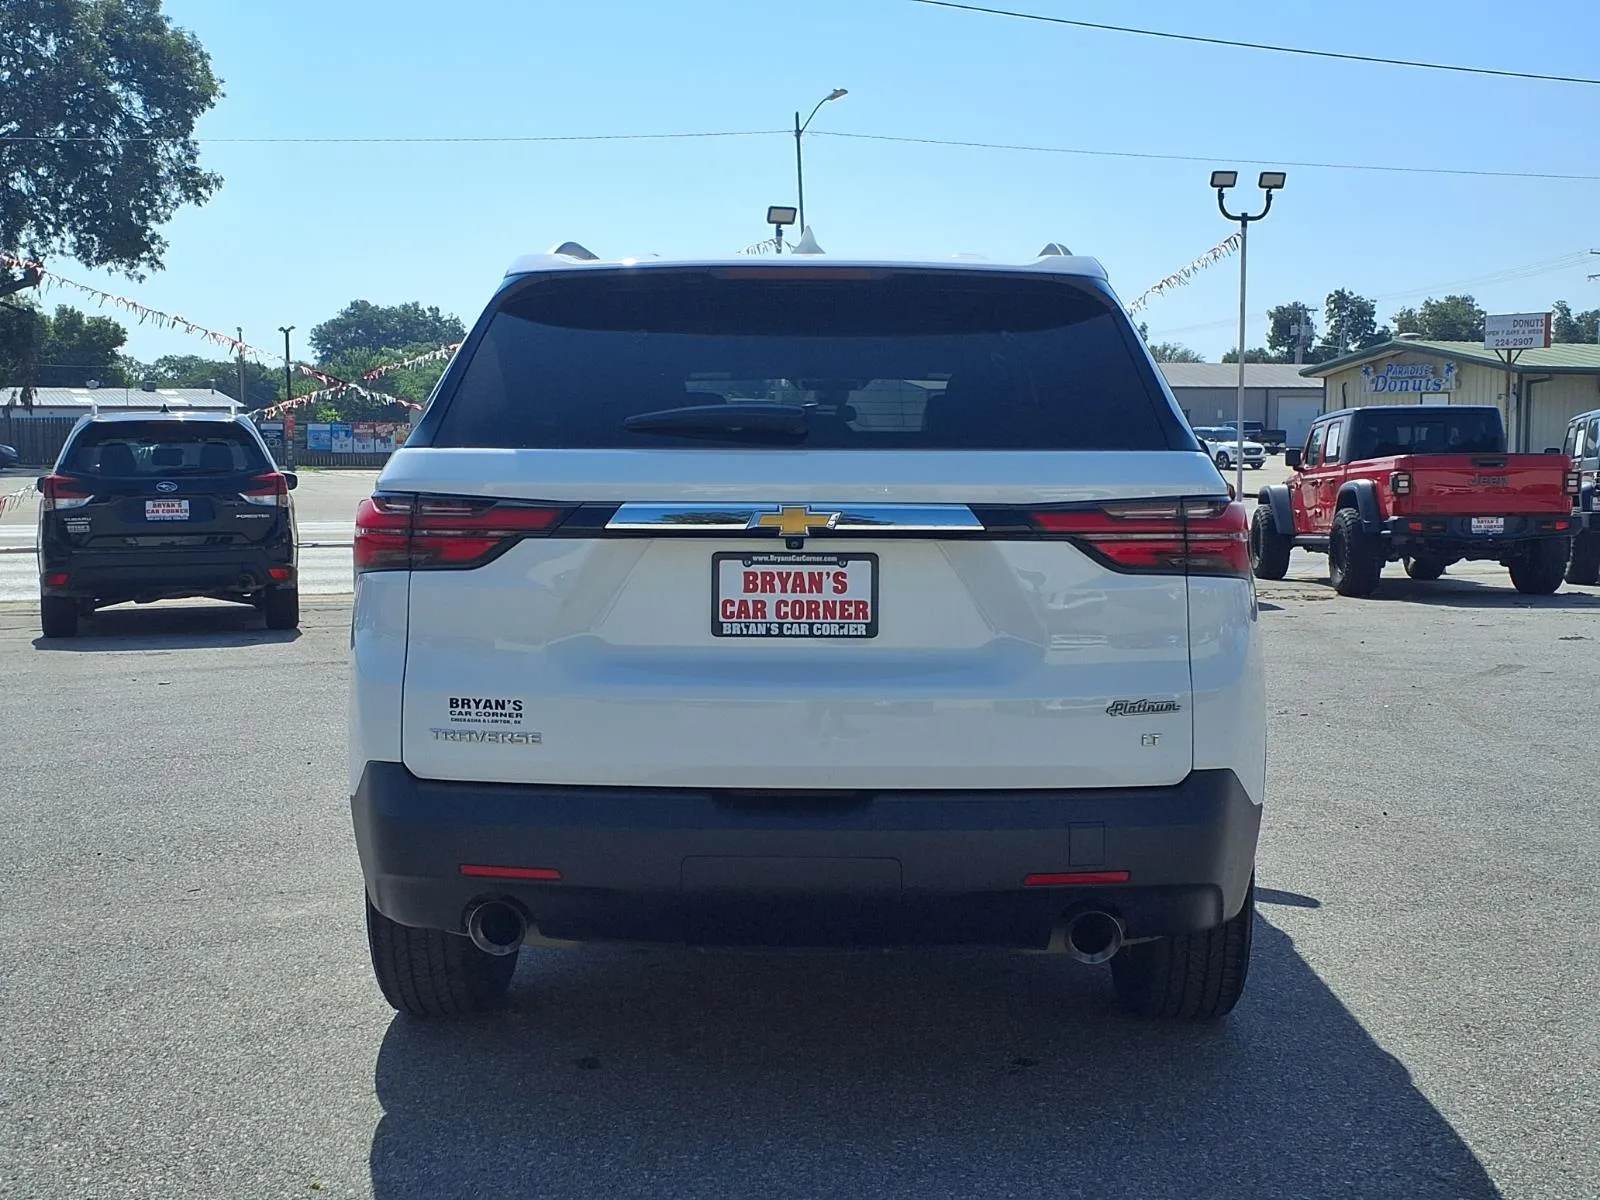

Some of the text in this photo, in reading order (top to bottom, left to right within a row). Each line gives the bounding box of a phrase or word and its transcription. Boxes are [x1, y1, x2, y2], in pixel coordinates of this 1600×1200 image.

[1512, 319, 1544, 328] DONUTS
[1495, 338, 1534, 347] 224-2907
[1373, 376, 1443, 392] Donuts
[1470, 474, 1510, 487] Jeep
[743, 571, 848, 594] BRYAN'S
[721, 599, 869, 621] CAR CORNER
[722, 623, 867, 636] BRYAN'S CAR CORNER
[449, 697, 523, 711] BRYAN'S
[1106, 699, 1182, 716] Platinum
[430, 727, 543, 745] TRAVERSE
[1141, 733, 1163, 746] LT
